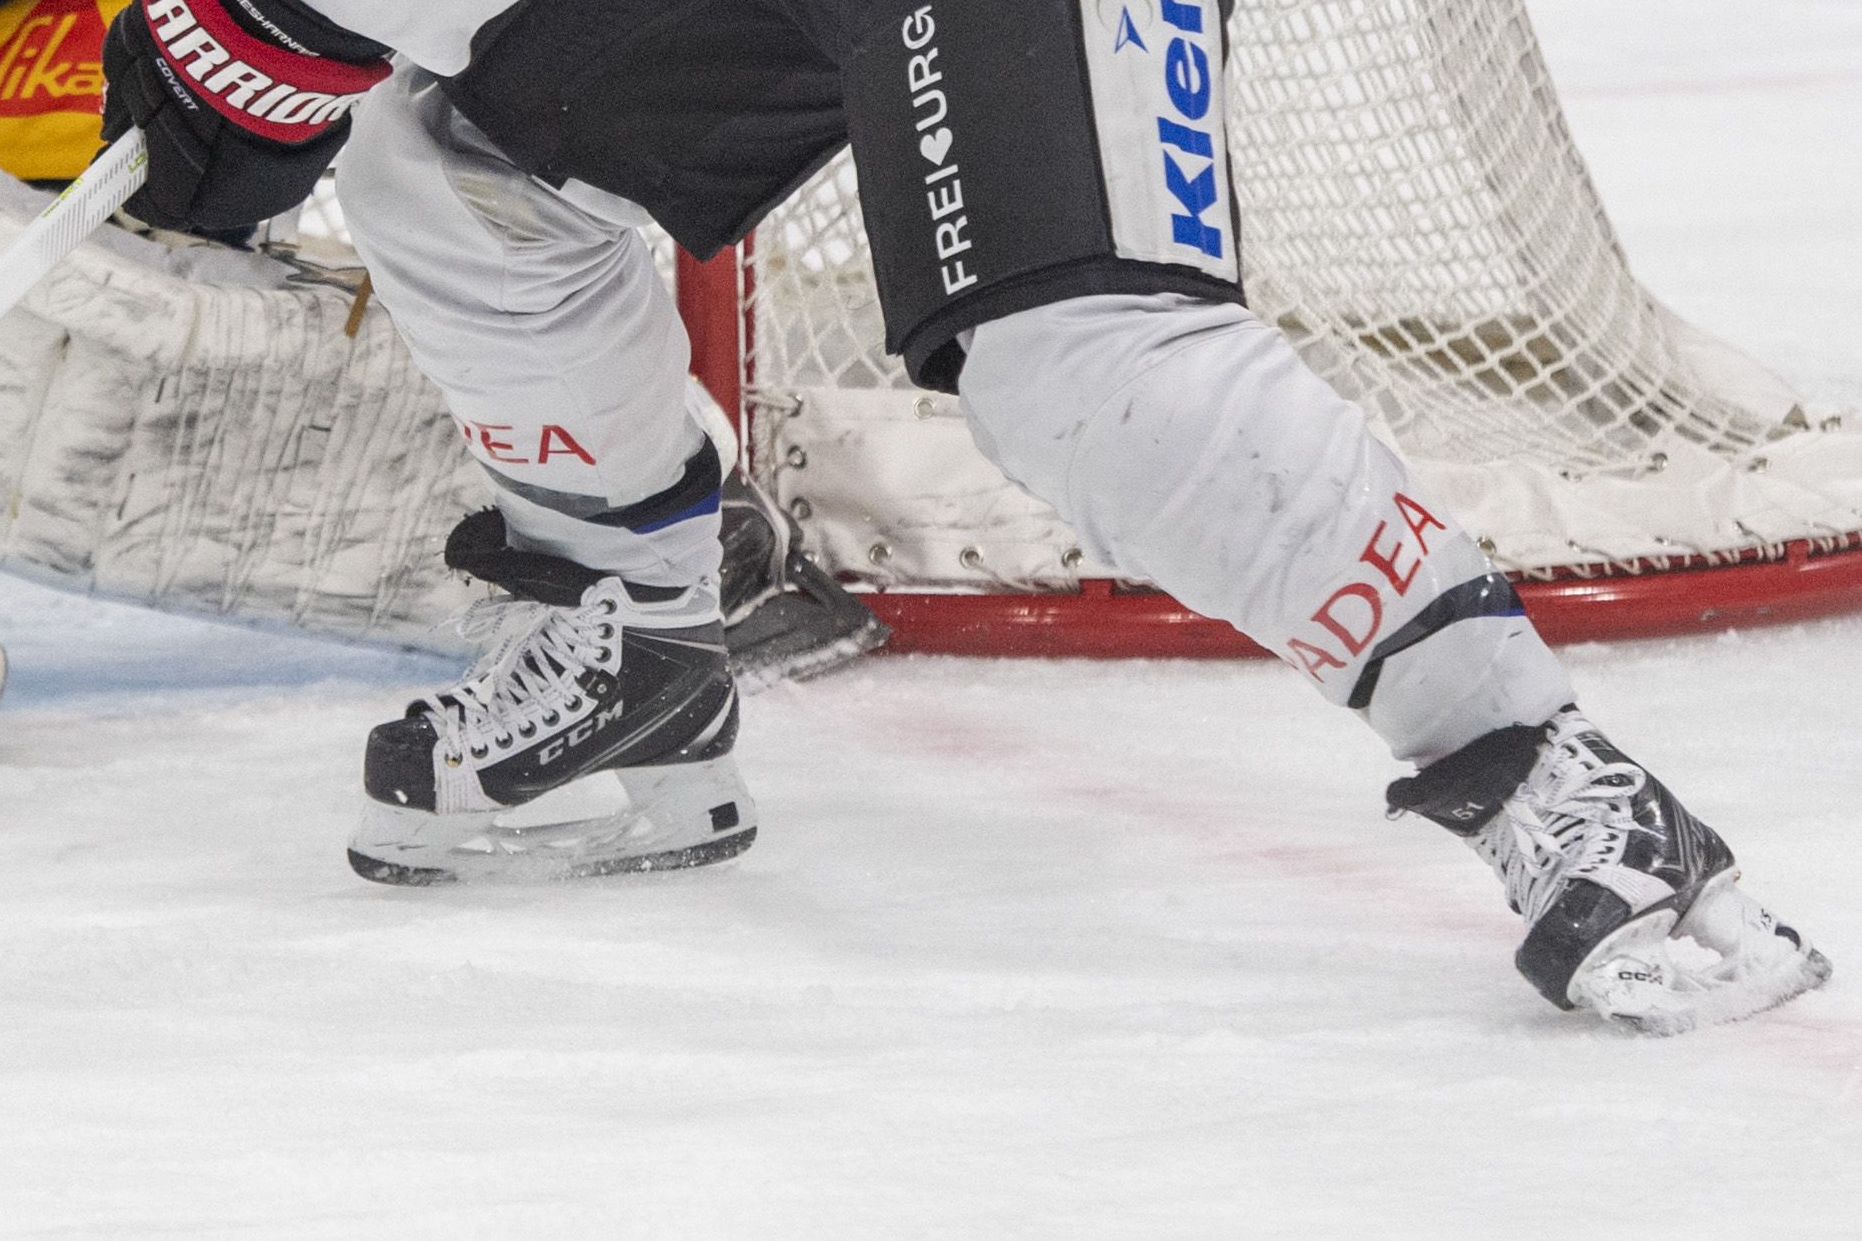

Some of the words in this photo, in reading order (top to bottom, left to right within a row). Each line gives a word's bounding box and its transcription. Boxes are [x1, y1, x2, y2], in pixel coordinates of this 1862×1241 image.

[155, 57, 200, 110] COVERT
[462, 422, 597, 466] EA
[1286, 492, 1446, 683] ADEA
[539, 699, 625, 765] CCM
